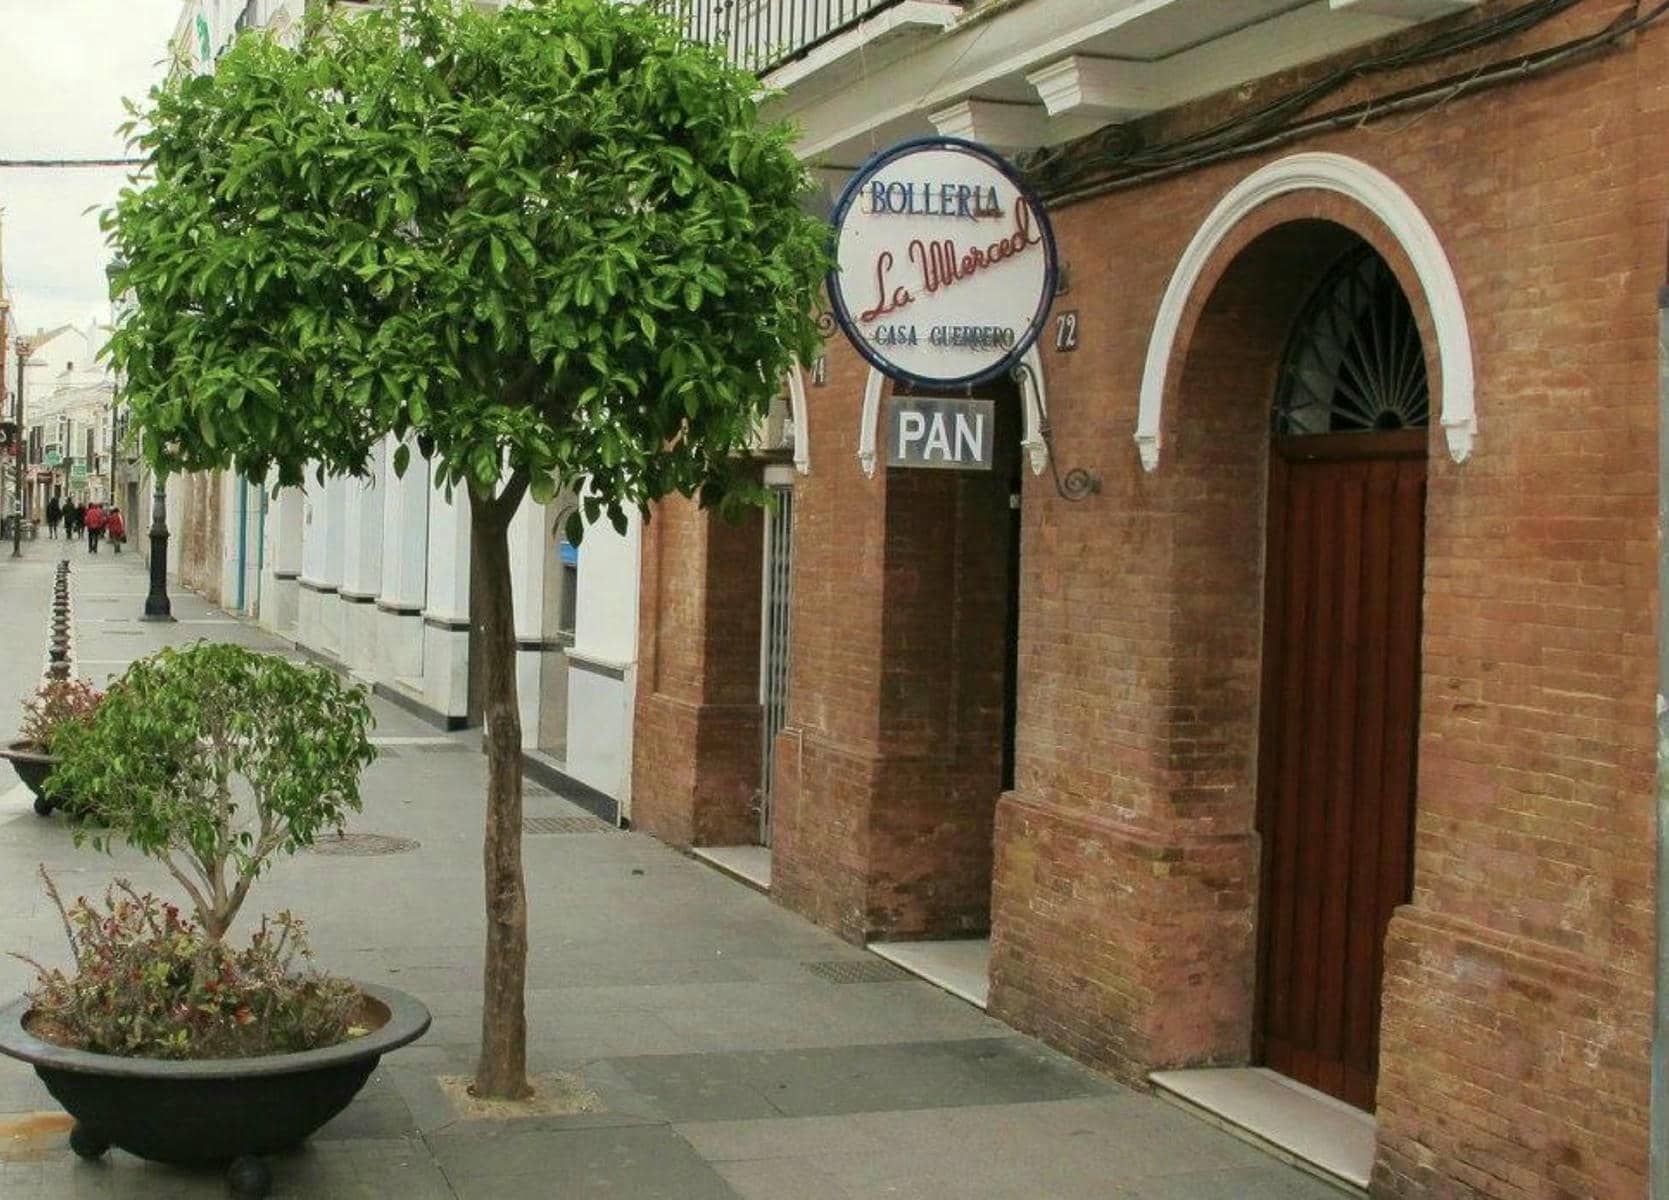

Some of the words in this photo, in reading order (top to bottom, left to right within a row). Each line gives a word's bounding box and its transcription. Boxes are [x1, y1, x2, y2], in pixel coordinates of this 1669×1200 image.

[860, 251, 916, 323] La
[908, 196, 1042, 293] Merced
[874, 324, 918, 346] CASA
[929, 325, 1016, 352] GUERRERO
[898, 411, 984, 462] PAN
